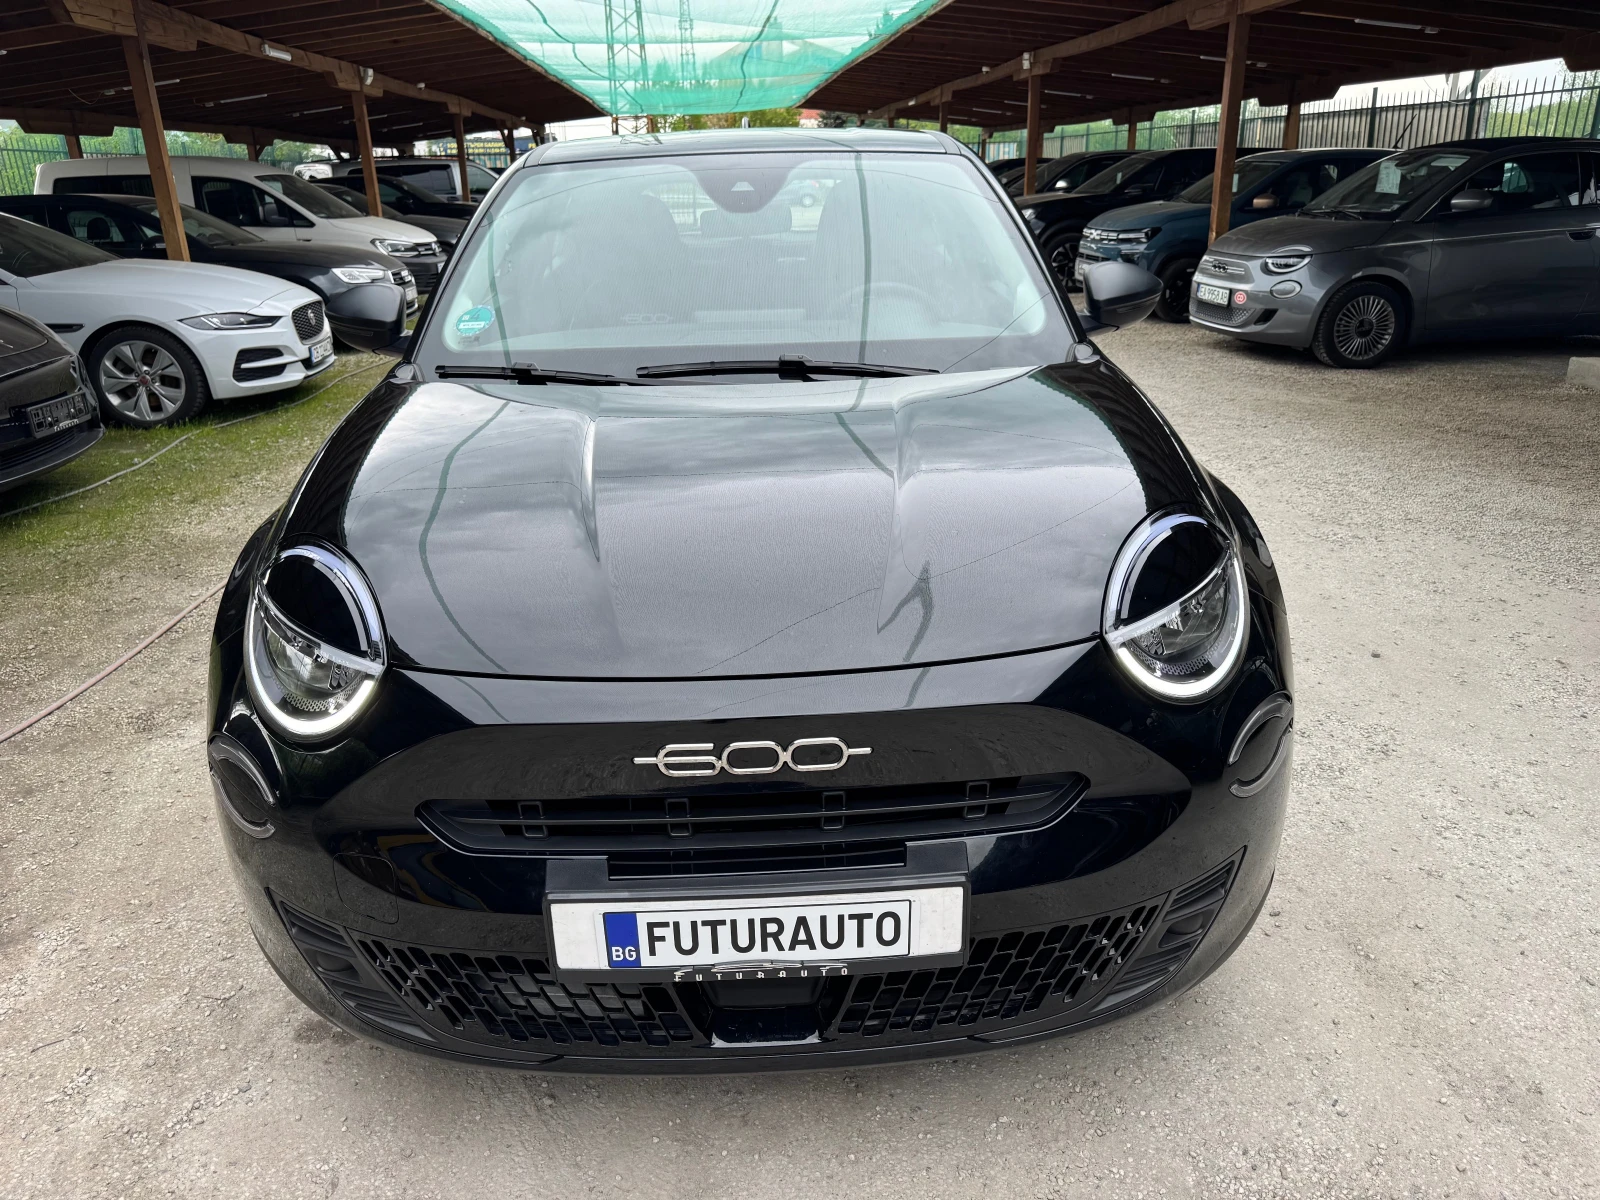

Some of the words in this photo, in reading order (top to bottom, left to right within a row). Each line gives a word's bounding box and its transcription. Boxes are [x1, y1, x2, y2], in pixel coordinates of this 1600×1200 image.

[634, 737, 872, 777] 600
[611, 946, 637, 961] BG
[646, 911, 901, 956] FUTURAUTO
[673, 967, 848, 982] FUTURAUTO
